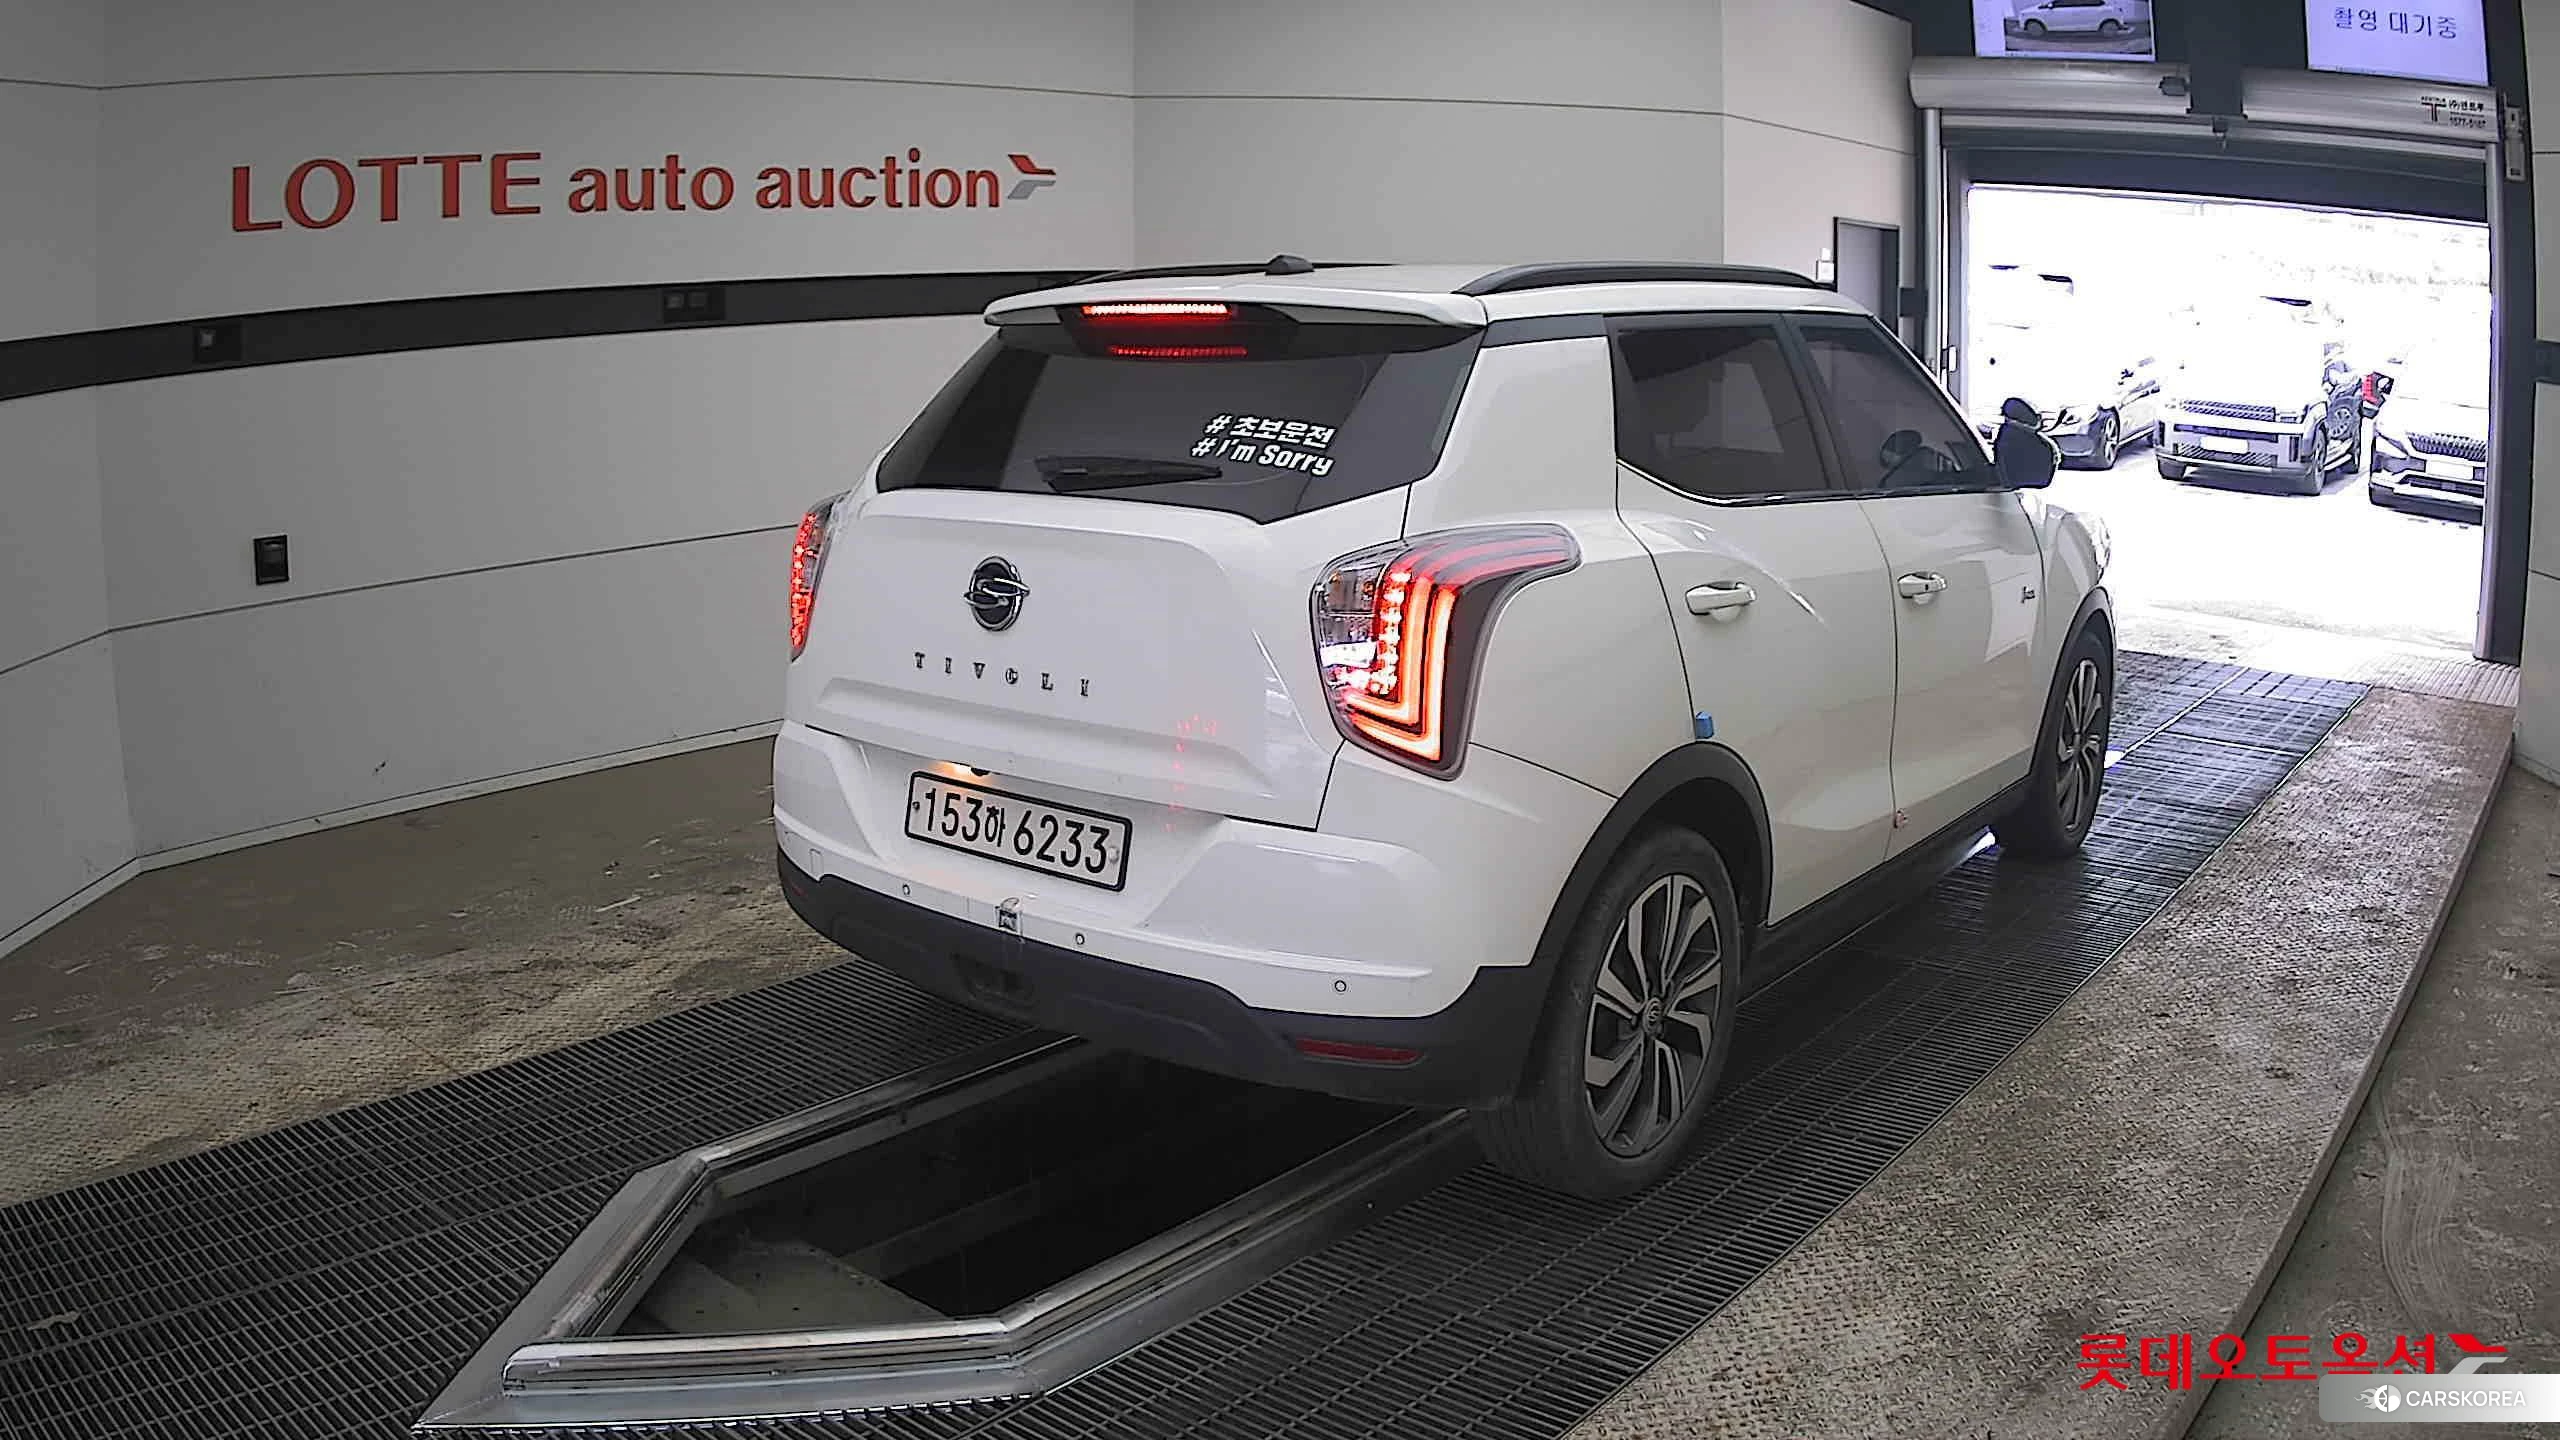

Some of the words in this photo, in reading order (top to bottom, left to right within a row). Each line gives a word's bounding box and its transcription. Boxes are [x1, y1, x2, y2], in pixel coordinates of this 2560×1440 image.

[2334, 6, 2377, 31] 촬영
[2389, 12, 2457, 40] 대기중
[231, 151, 542, 233] LOTTE
[568, 154, 735, 212] auto
[756, 148, 1001, 209] auction
[1257, 443, 1335, 477] Sorry
[914, 651, 1090, 697] TIVOLI
[924, 787, 1006, 848] 153하
[1013, 810, 1110, 874] 6233
